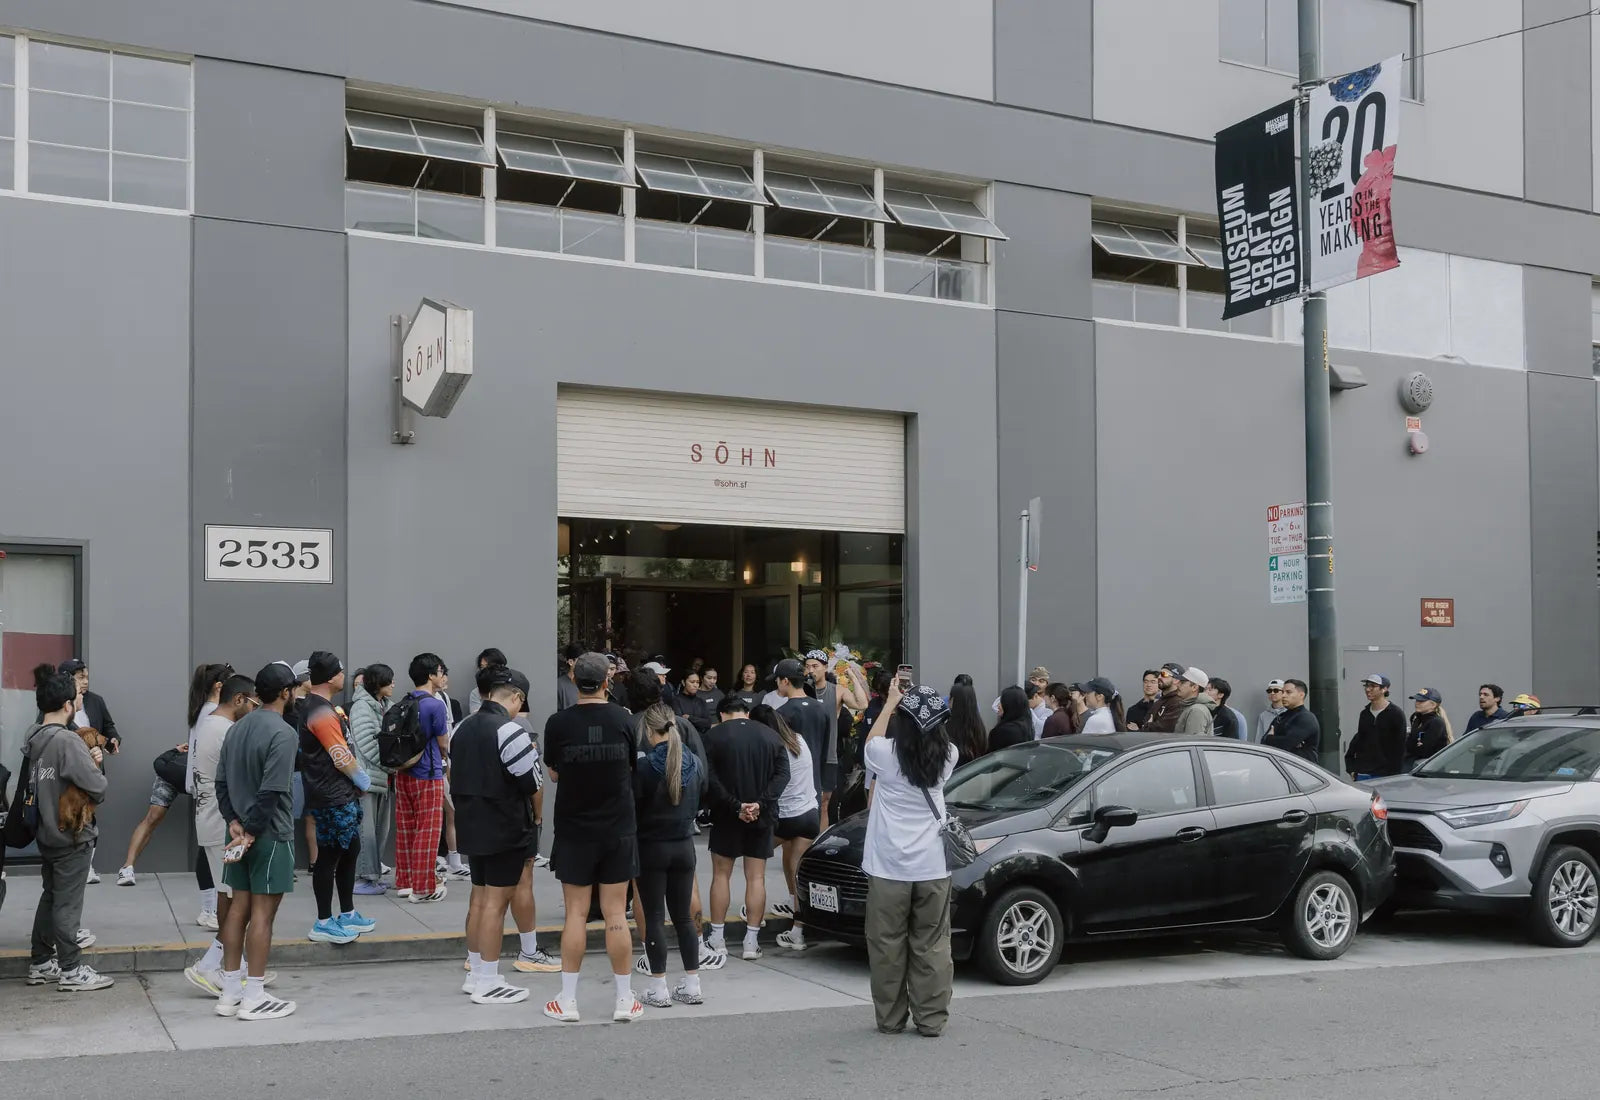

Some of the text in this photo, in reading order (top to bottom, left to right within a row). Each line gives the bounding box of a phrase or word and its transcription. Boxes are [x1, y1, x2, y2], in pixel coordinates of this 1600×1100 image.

[1364, 188, 1373, 199] IN
[1319, 191, 1363, 230] YEARS
[1365, 198, 1380, 212] THE
[1222, 183, 1252, 303] MUSEUM
[1269, 186, 1295, 289] DESIGN
[1320, 212, 1382, 257] MAKING
[1247, 210, 1271, 296] CRAFT
[1268, 507, 1304, 520] NO PARKING
[1271, 536, 1281, 544] TUE
[219, 539, 320, 569] 2535
[1270, 558, 1300, 569] 4 HOUR
[1273, 570, 1303, 582] PARKING
